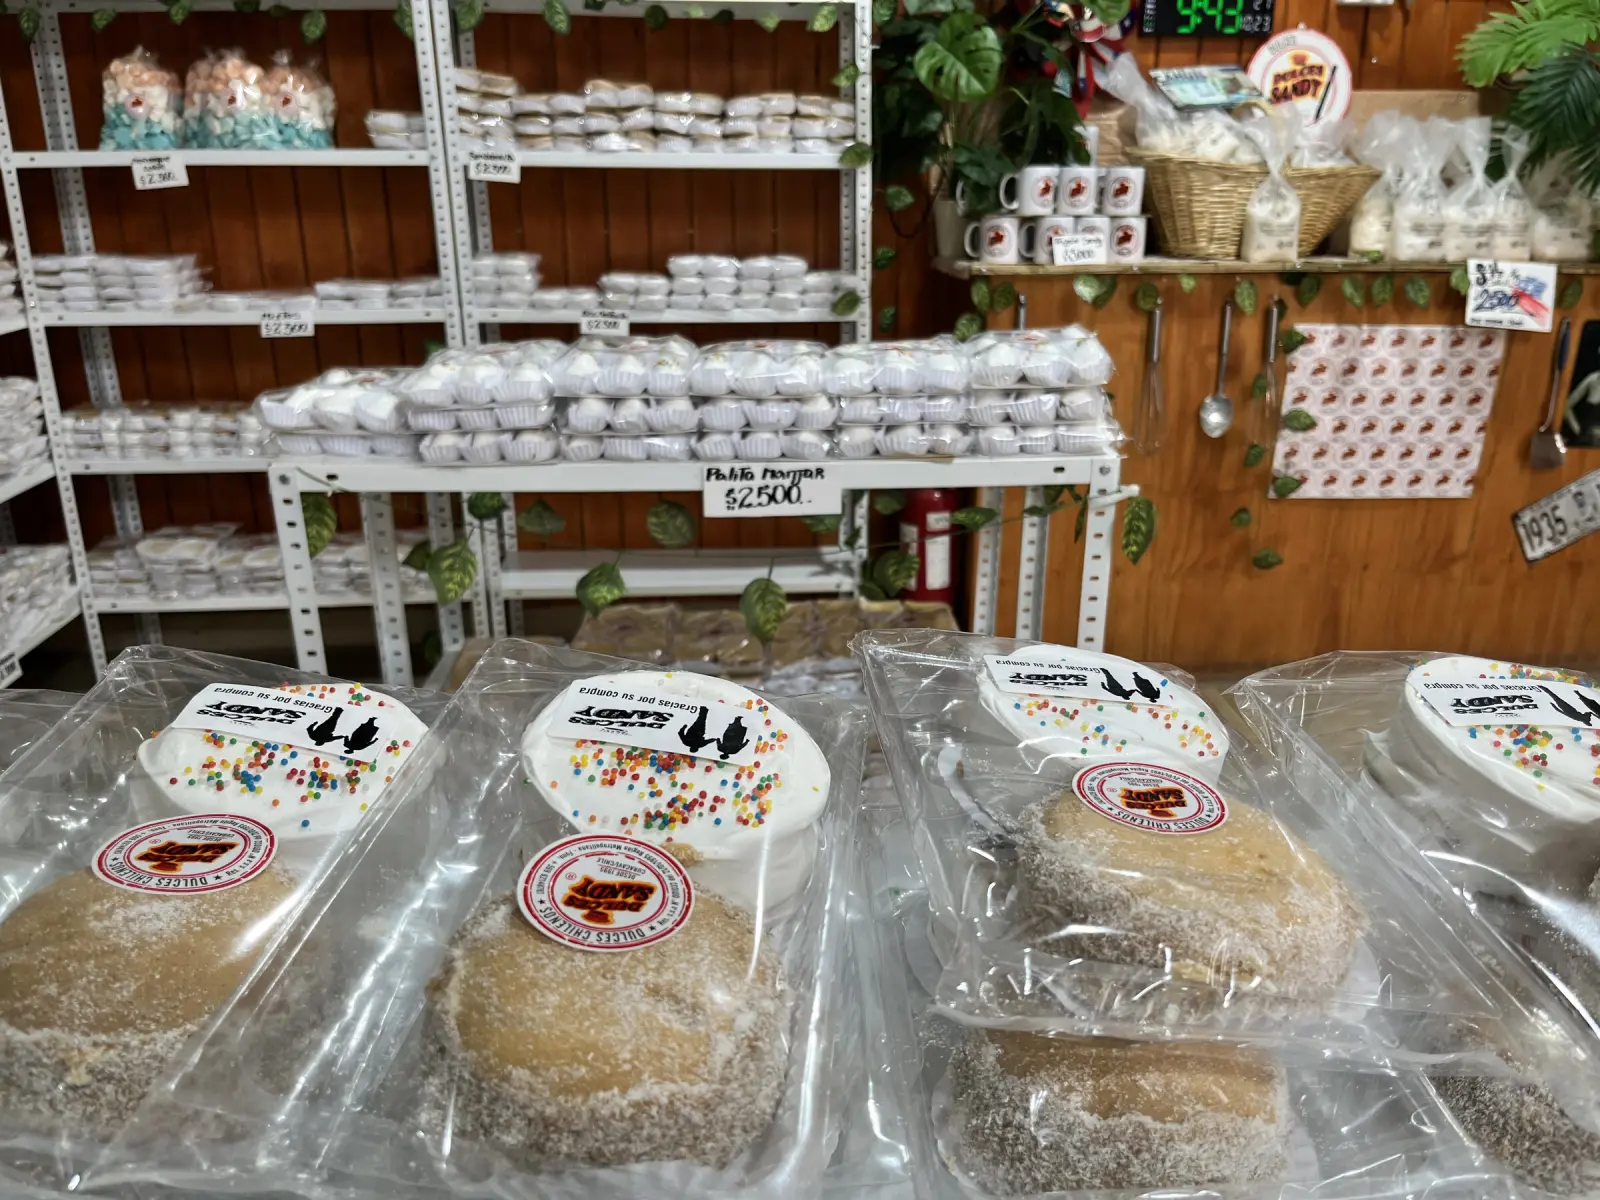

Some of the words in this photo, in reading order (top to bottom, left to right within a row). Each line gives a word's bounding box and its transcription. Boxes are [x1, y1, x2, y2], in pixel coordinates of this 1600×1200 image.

[1521, 504, 1568, 552] 1935
[1065, 665, 1101, 674] Gracias
[1009, 672, 1088, 682] SANDY
[213, 687, 255, 697] compra
[579, 687, 619, 698] compra
[1423, 682, 1464, 690] compra
[1500, 684, 1542, 693] Gracias
[257, 692, 271, 700] su
[272, 694, 292, 704] por
[621, 692, 634, 700] su
[637, 695, 656, 704] por
[1450, 694, 1534, 708] SANDY
[205, 701, 307, 720] SANDY
[293, 698, 334, 714] Gracias
[658, 699, 698, 714] Gracias
[196, 709, 297, 725] DULCES
[574, 705, 675, 722] SANDY
[568, 716, 667, 730] DULCES
[1122, 787, 1184, 802] SANDY
[1125, 799, 1188, 809] DULCES
[1115, 810, 1171, 830] CHILENOS
[1173, 816, 1210, 829] DULCES
[148, 841, 238, 856] SANDY
[135, 851, 221, 863] DULCES
[109, 861, 154, 884] CHILENOS
[615, 870, 637, 880] DESDE
[155, 876, 208, 888] DULCES
[569, 878, 655, 903] SANDY
[562, 895, 644, 912] DULCES
[539, 906, 592, 940] CHILENOS
[596, 927, 646, 943] DULCES
